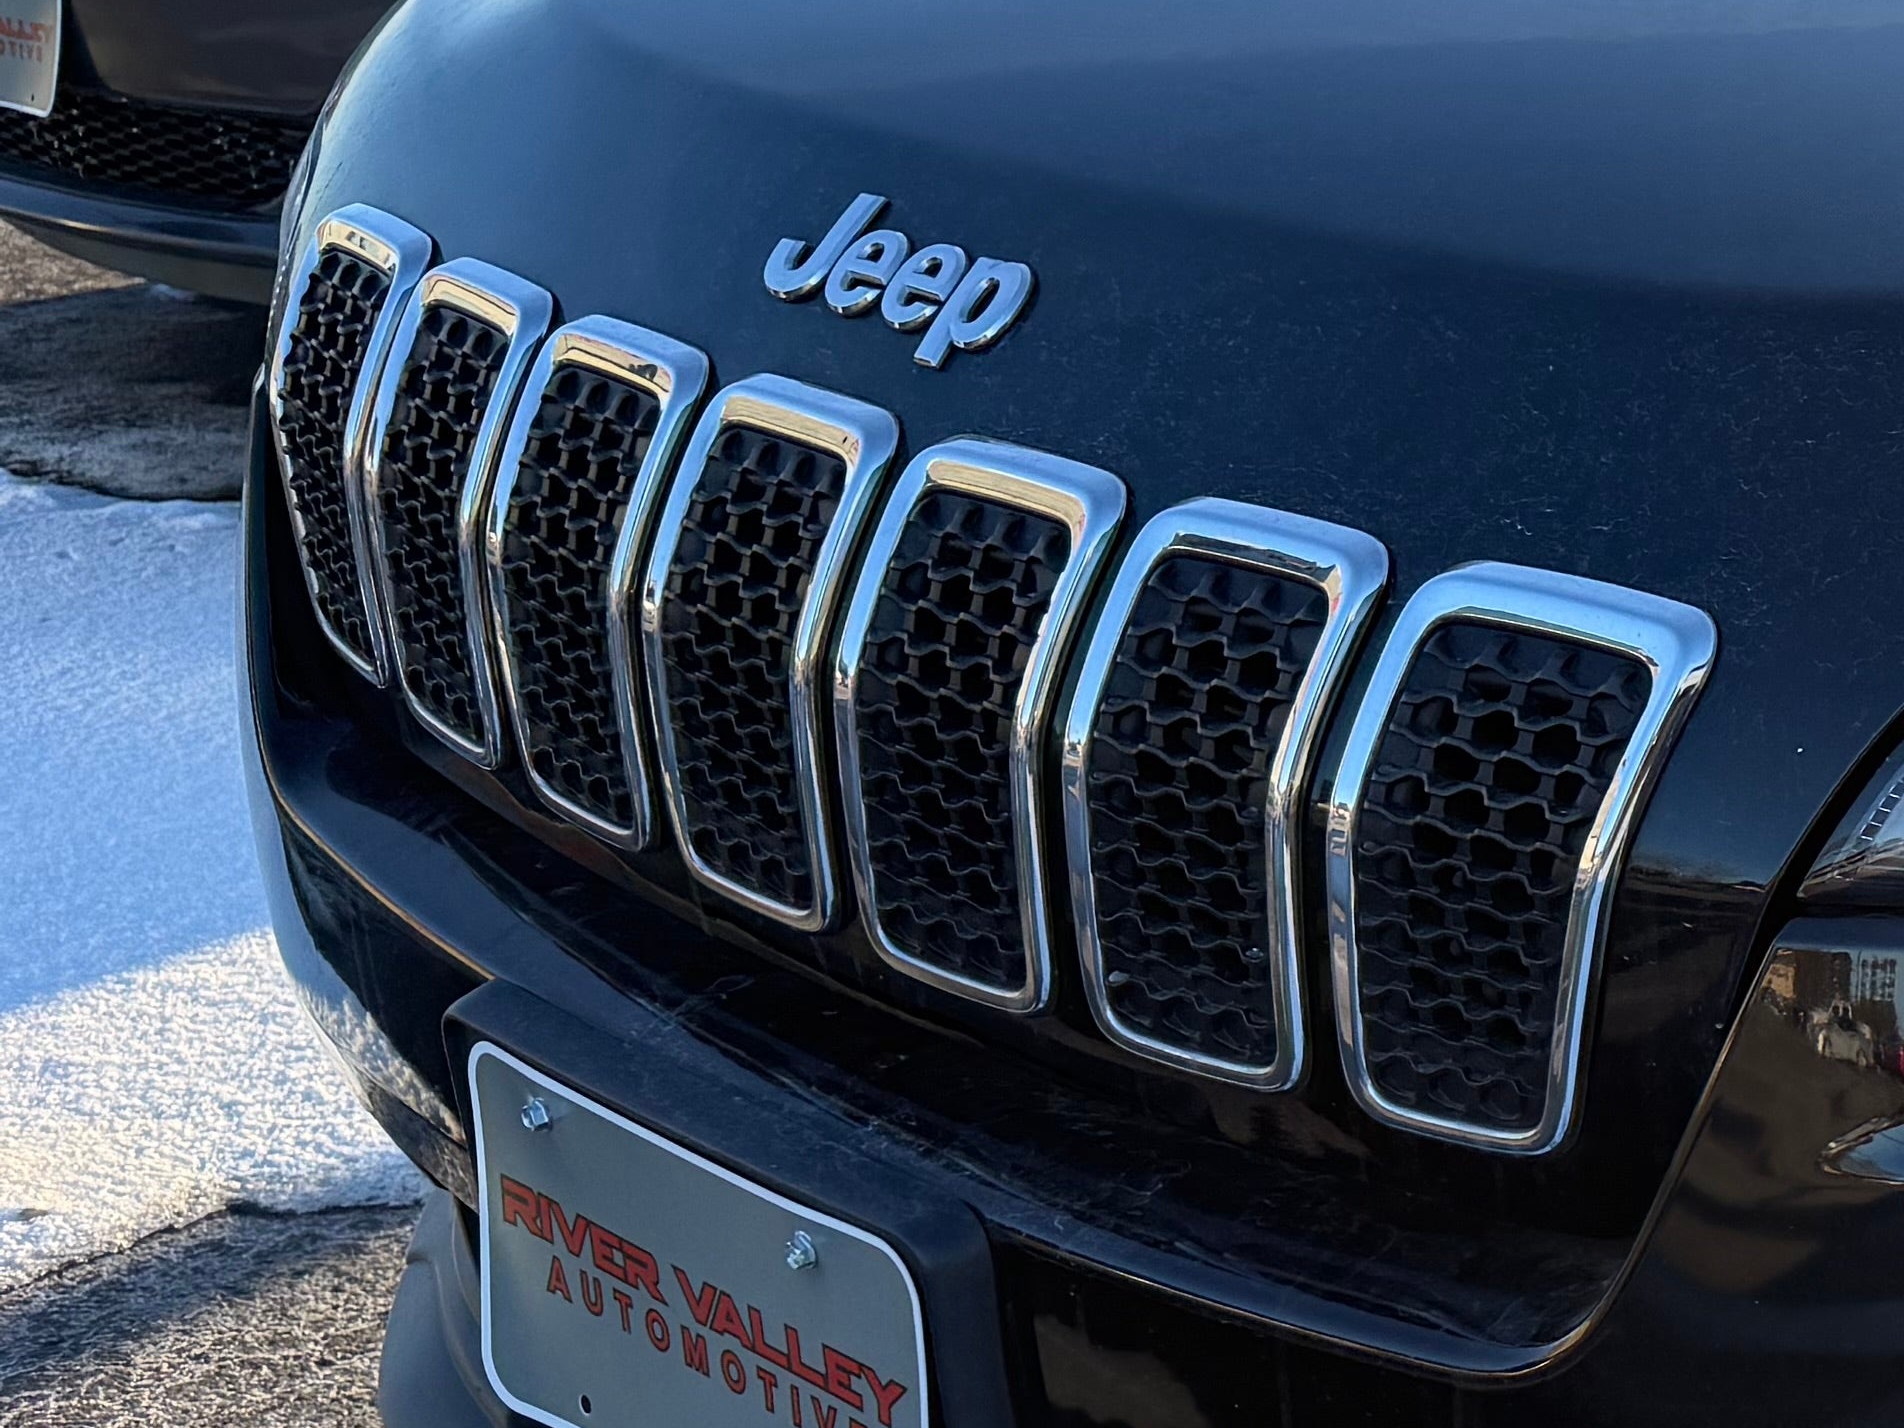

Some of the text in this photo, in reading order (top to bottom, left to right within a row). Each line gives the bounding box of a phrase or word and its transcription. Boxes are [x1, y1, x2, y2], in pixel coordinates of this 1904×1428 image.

[763, 192, 1033, 369] Jeep
[500, 1174, 907, 1428] RIVER VALLEY
